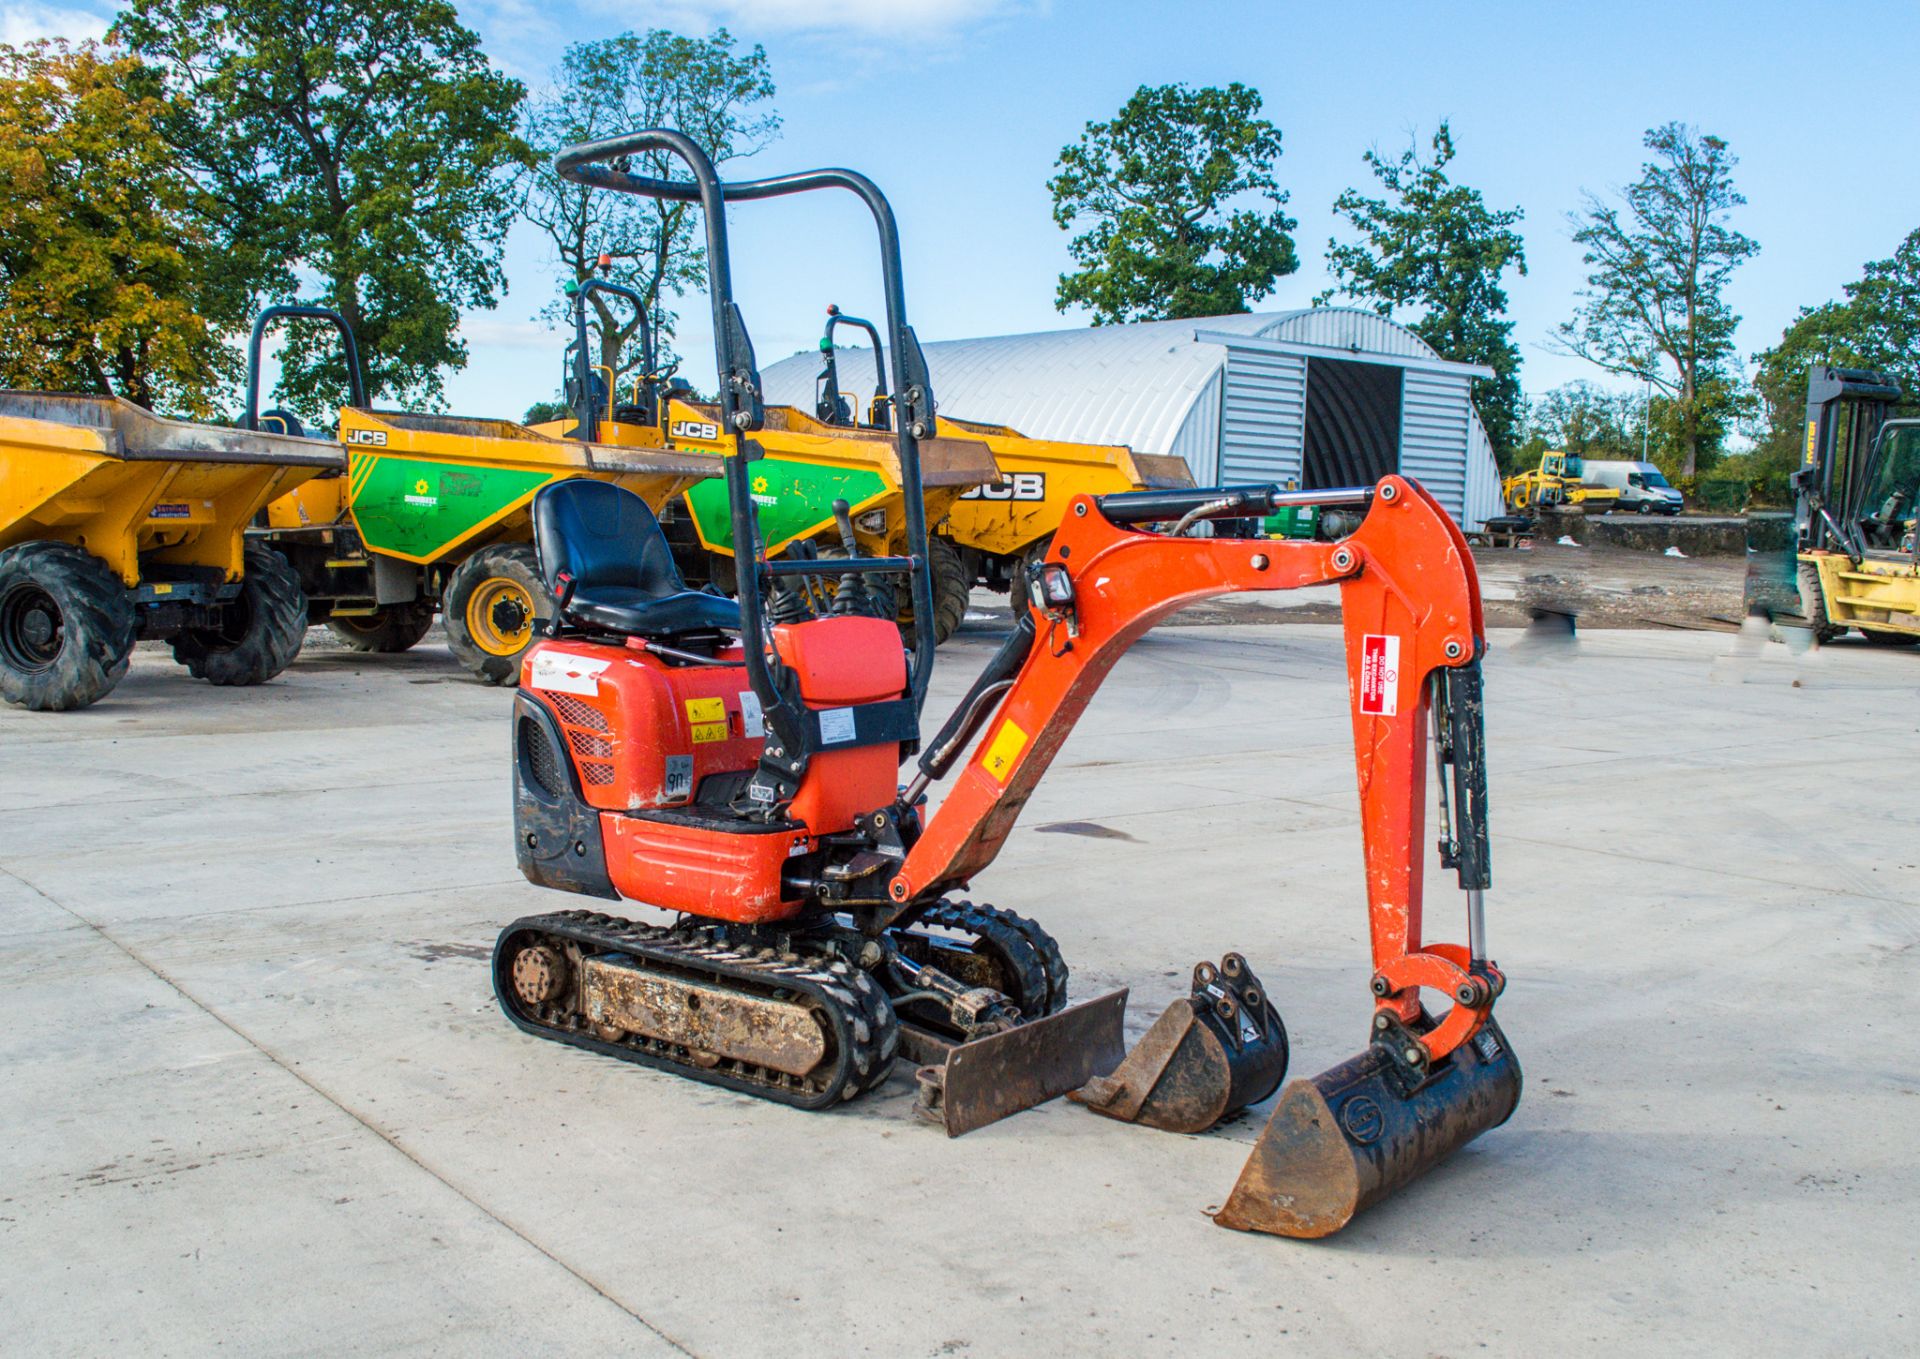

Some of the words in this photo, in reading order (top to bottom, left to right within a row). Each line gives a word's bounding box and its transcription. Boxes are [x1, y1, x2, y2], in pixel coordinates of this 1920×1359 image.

[348, 430, 387, 446] JCB
[672, 422, 717, 440] JCB
[1806, 421, 1816, 464] HYSTER
[1365, 655, 1371, 665] AS
[1379, 656, 1385, 665] DO
